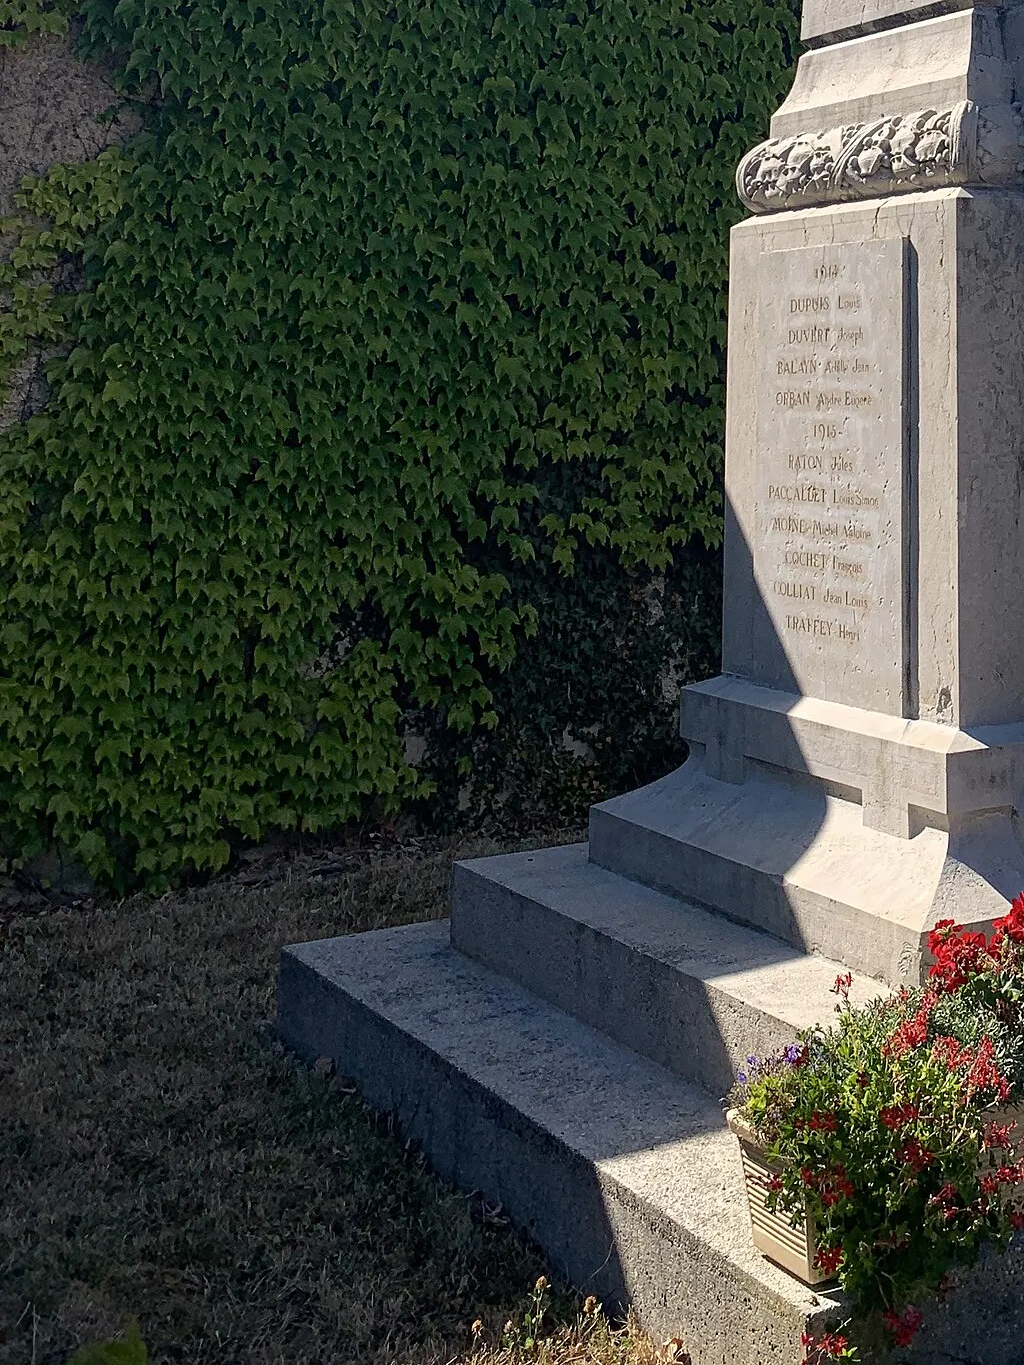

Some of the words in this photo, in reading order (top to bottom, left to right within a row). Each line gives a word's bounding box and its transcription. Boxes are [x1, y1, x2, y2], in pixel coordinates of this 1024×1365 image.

[790, 297, 830, 313] DUPUIS
[838, 295, 861, 310] Louis
[788, 328, 830, 344] DUVERT
[775, 391, 810, 408] ORBAN
[831, 455, 853, 471] Jules
[785, 551, 826, 568] COCHET
[773, 582, 816, 601] COLLIAT
[823, 589, 843, 604] Jean
[845, 591, 868, 609] Louis
